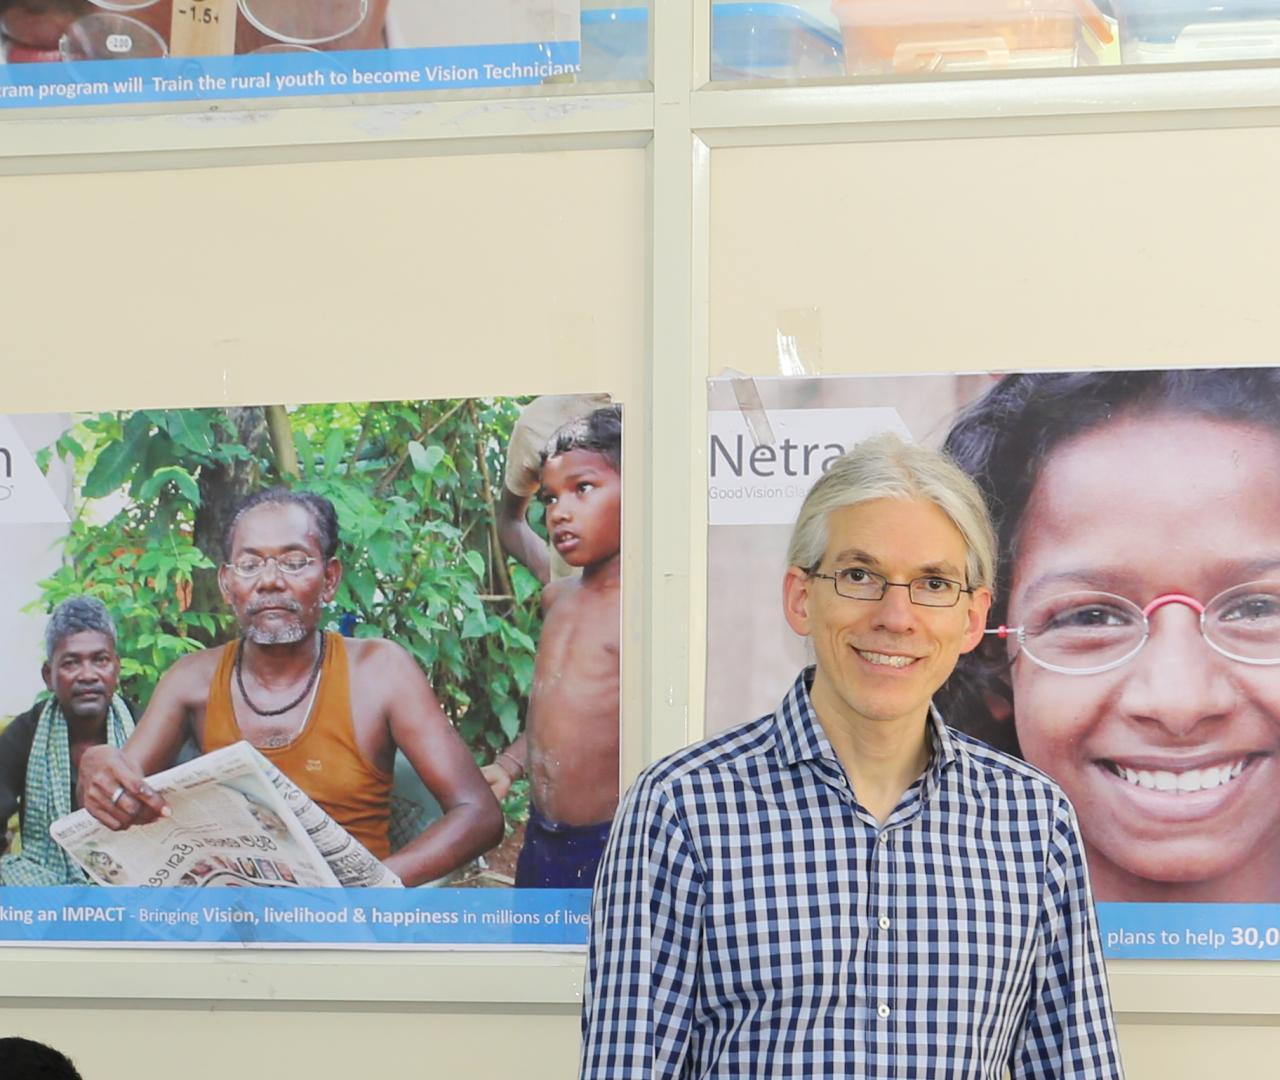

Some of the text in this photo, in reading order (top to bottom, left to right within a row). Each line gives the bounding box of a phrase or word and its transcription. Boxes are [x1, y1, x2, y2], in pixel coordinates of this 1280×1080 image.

[39, 80, 108, 99] program
[113, 77, 143, 94] will
[152, 76, 193, 92] Train
[198, 74, 226, 90] the
[231, 72, 270, 89] rural
[276, 70, 324, 90] youth
[330, 72, 347, 85] to
[352, 66, 420, 84] become
[425, 64, 478, 81] Vision
[710, 434, 846, 477] Netra
[37, 908, 57, 922] an
[62, 906, 126, 922] IMPACT
[139, 907, 199, 925] Bringing
[202, 907, 260, 926] Vision,
[264, 907, 347, 923] livelihood
[352, 907, 367, 923] &
[372, 907, 458, 928] happiness
[464, 909, 477, 924] in
[482, 909, 540, 925] millions
[544, 909, 561, 925] of
[564, 909, 591, 925] live
[1108, 928, 1156, 948] plans
[1161, 931, 1179, 946] to
[1186, 928, 1225, 949] help
